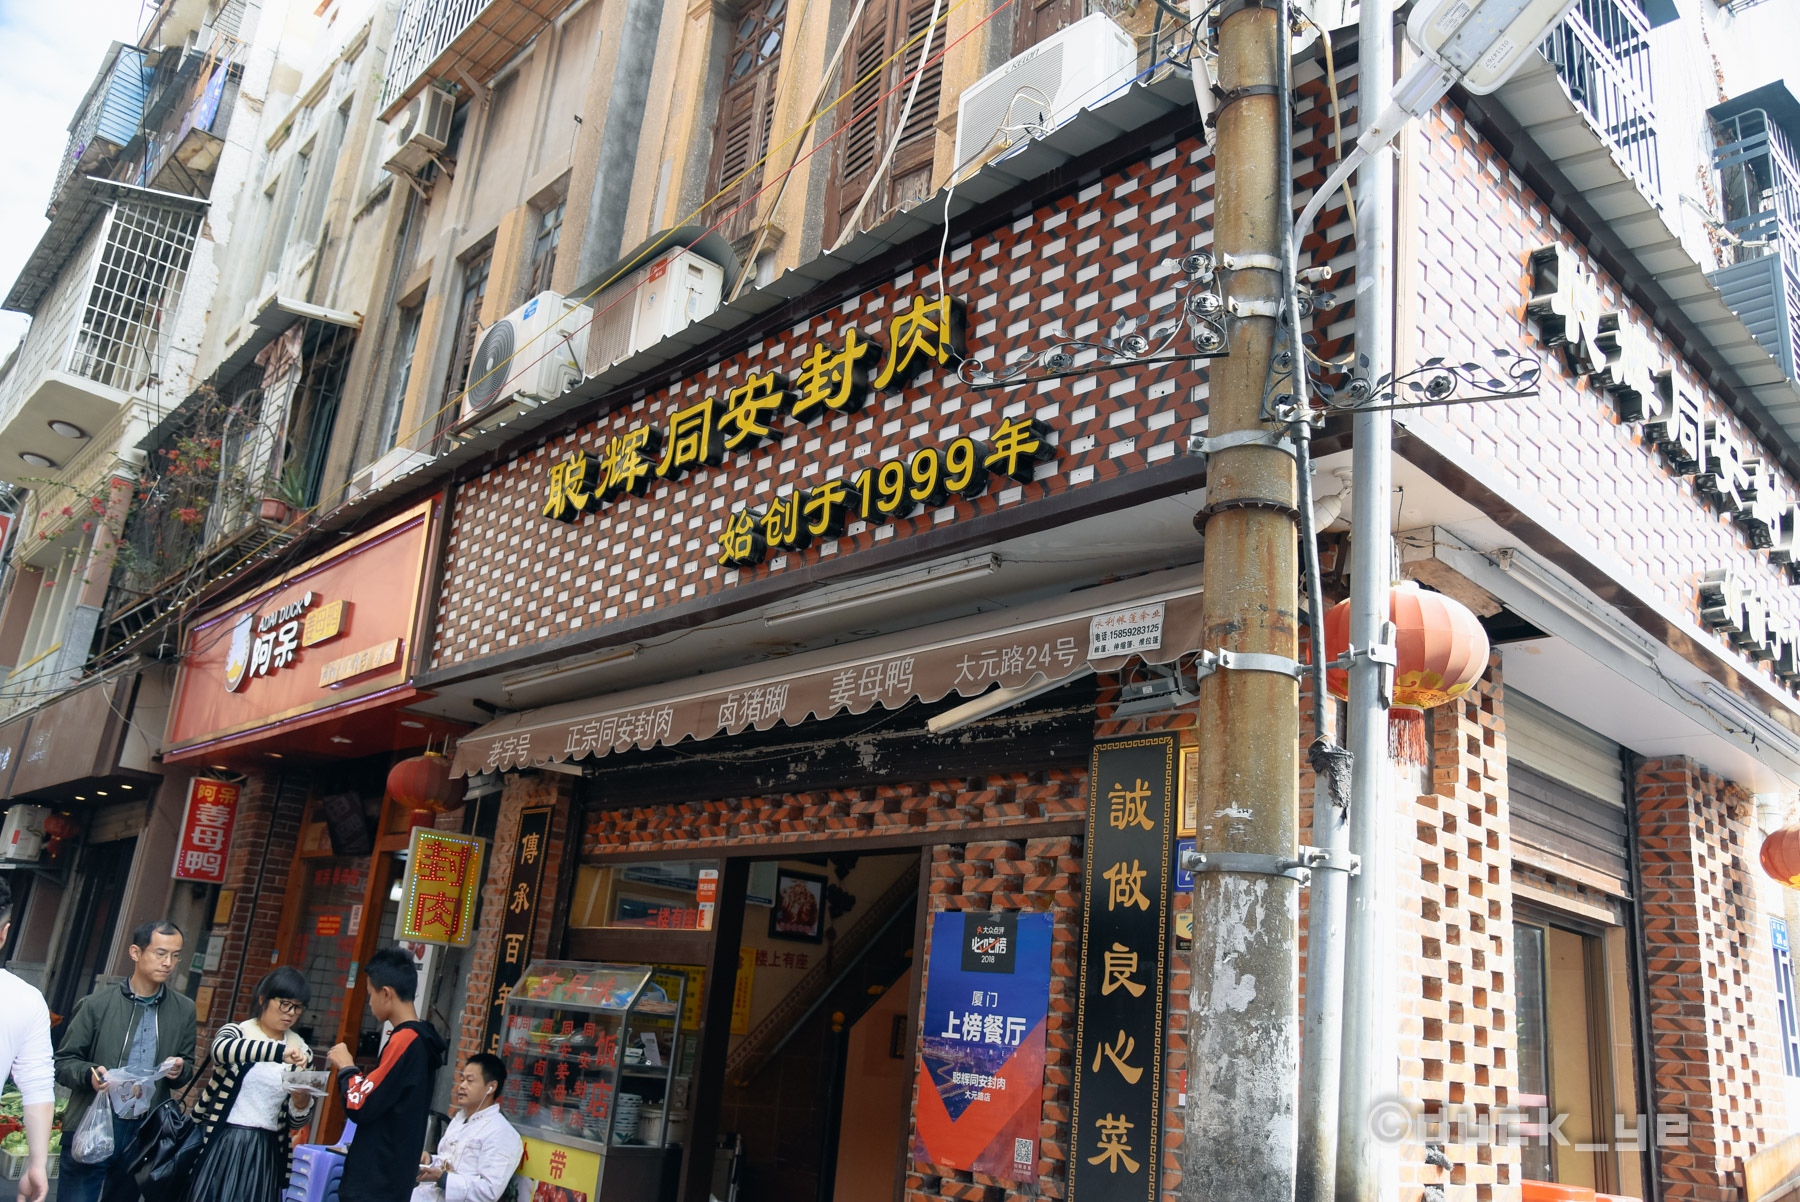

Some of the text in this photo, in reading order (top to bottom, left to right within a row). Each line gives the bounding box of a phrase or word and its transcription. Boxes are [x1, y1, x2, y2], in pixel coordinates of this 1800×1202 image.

[541, 293, 954, 521] 聪辉同安封肉
[717, 416, 1042, 565] 始创于1999年
[279, 599, 305, 621] DUCK
[249, 620, 299, 678] 阿呆
[487, 636, 1079, 767] 老字号 正宗同安封肉 卤猪脚 姜母鸭 大元路24号
[197, 783, 237, 804] 阿呆
[184, 802, 231, 877] 姜母鸭
[412, 840, 472, 936] 封肉
[646, 907, 698, 929] 二楼有座
[982, 926, 1005, 935] 大众点评
[971, 936, 1007, 954] 必吃榜
[756, 950, 809, 970] 楼上有座
[981, 955, 996, 964] 2018
[1087, 778, 1155, 1174] 誠做良心菜
[528, 971, 617, 1005] 古早味
[971, 990, 999, 1008] 厦门
[941, 1010, 1027, 1046] 上榜餐厅
[952, 1071, 1007, 1091] 聪辉同安封肉
[964, 1089, 992, 1103] 大元路店
